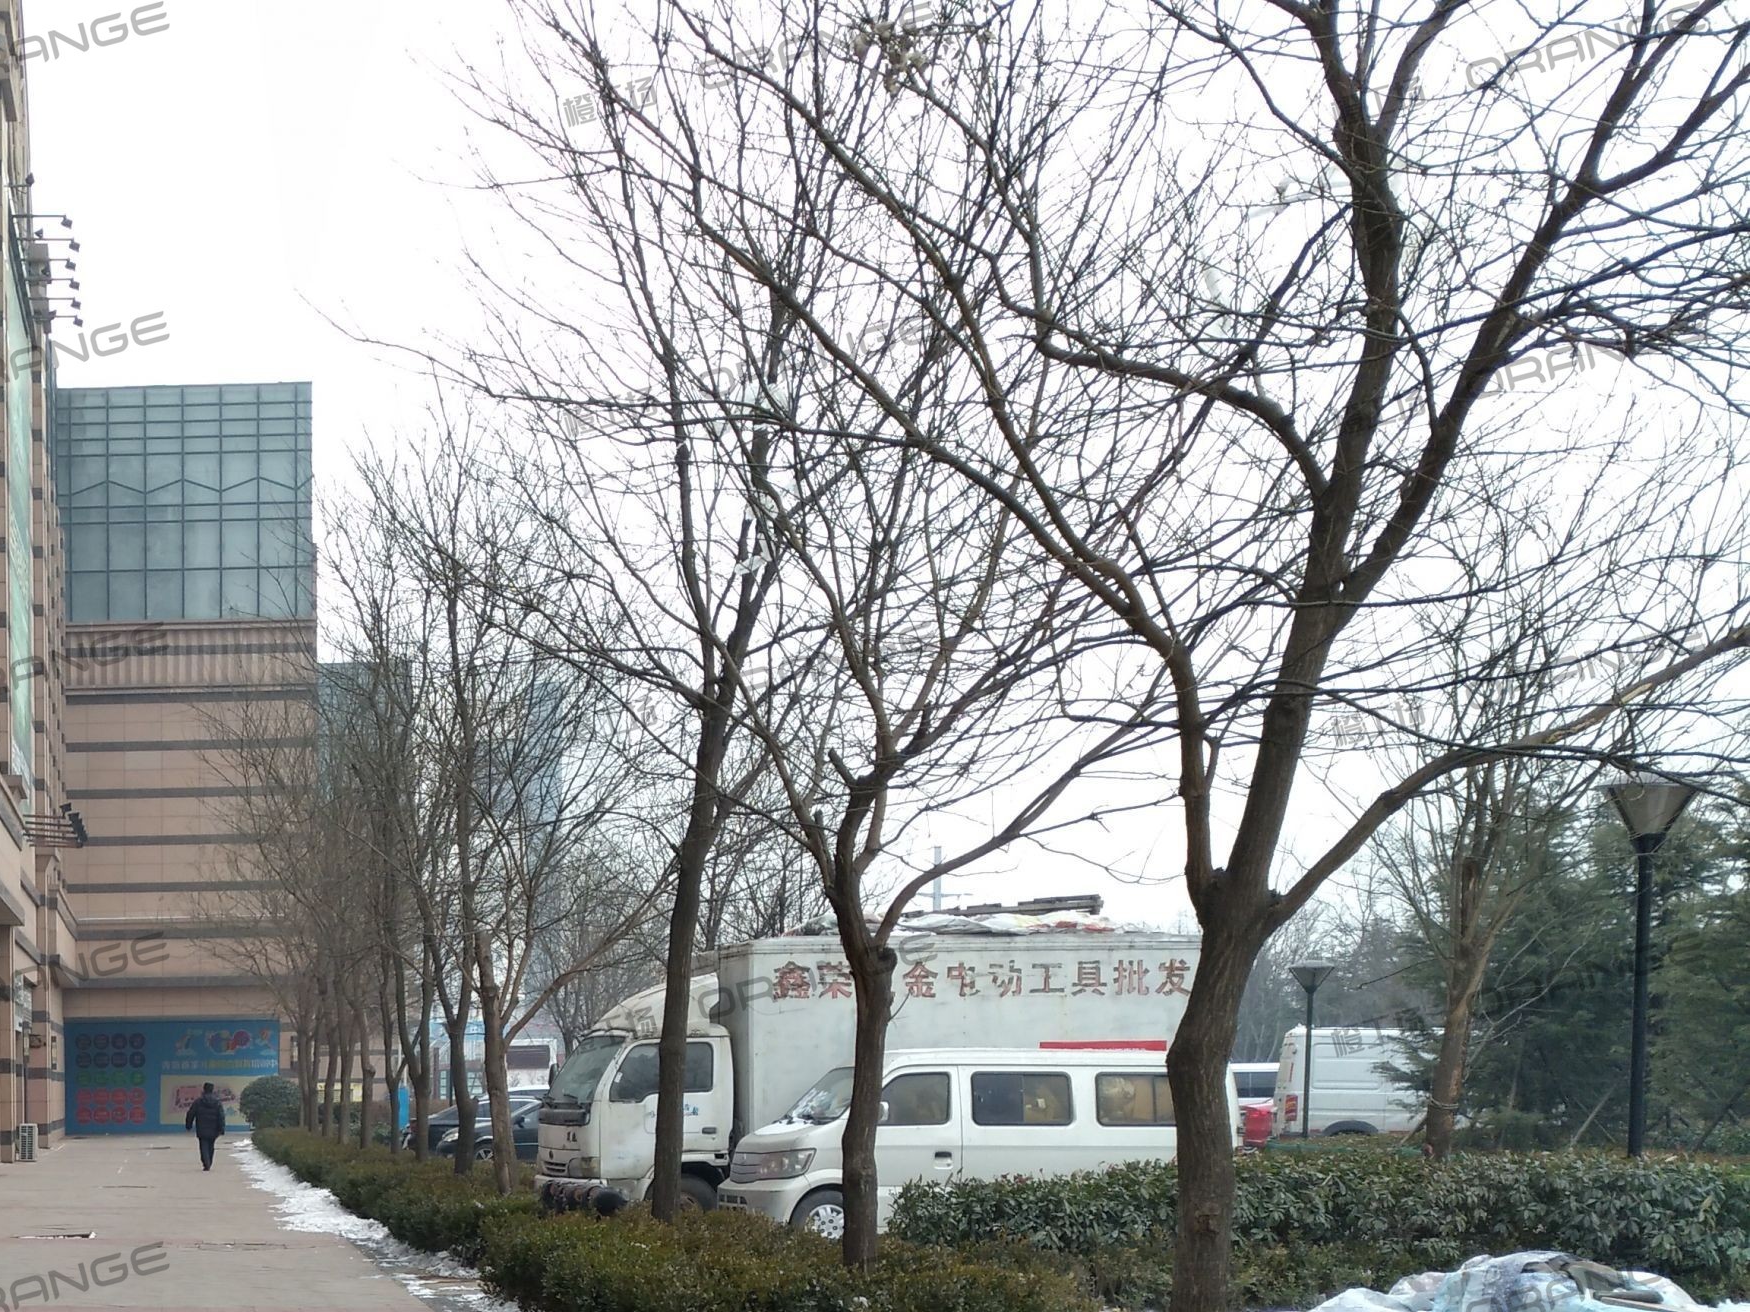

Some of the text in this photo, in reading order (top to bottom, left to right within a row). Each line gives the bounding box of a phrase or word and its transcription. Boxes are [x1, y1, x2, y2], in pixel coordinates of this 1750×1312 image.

[771, 958, 1192, 1001] 鑫荣金电动工具批发
